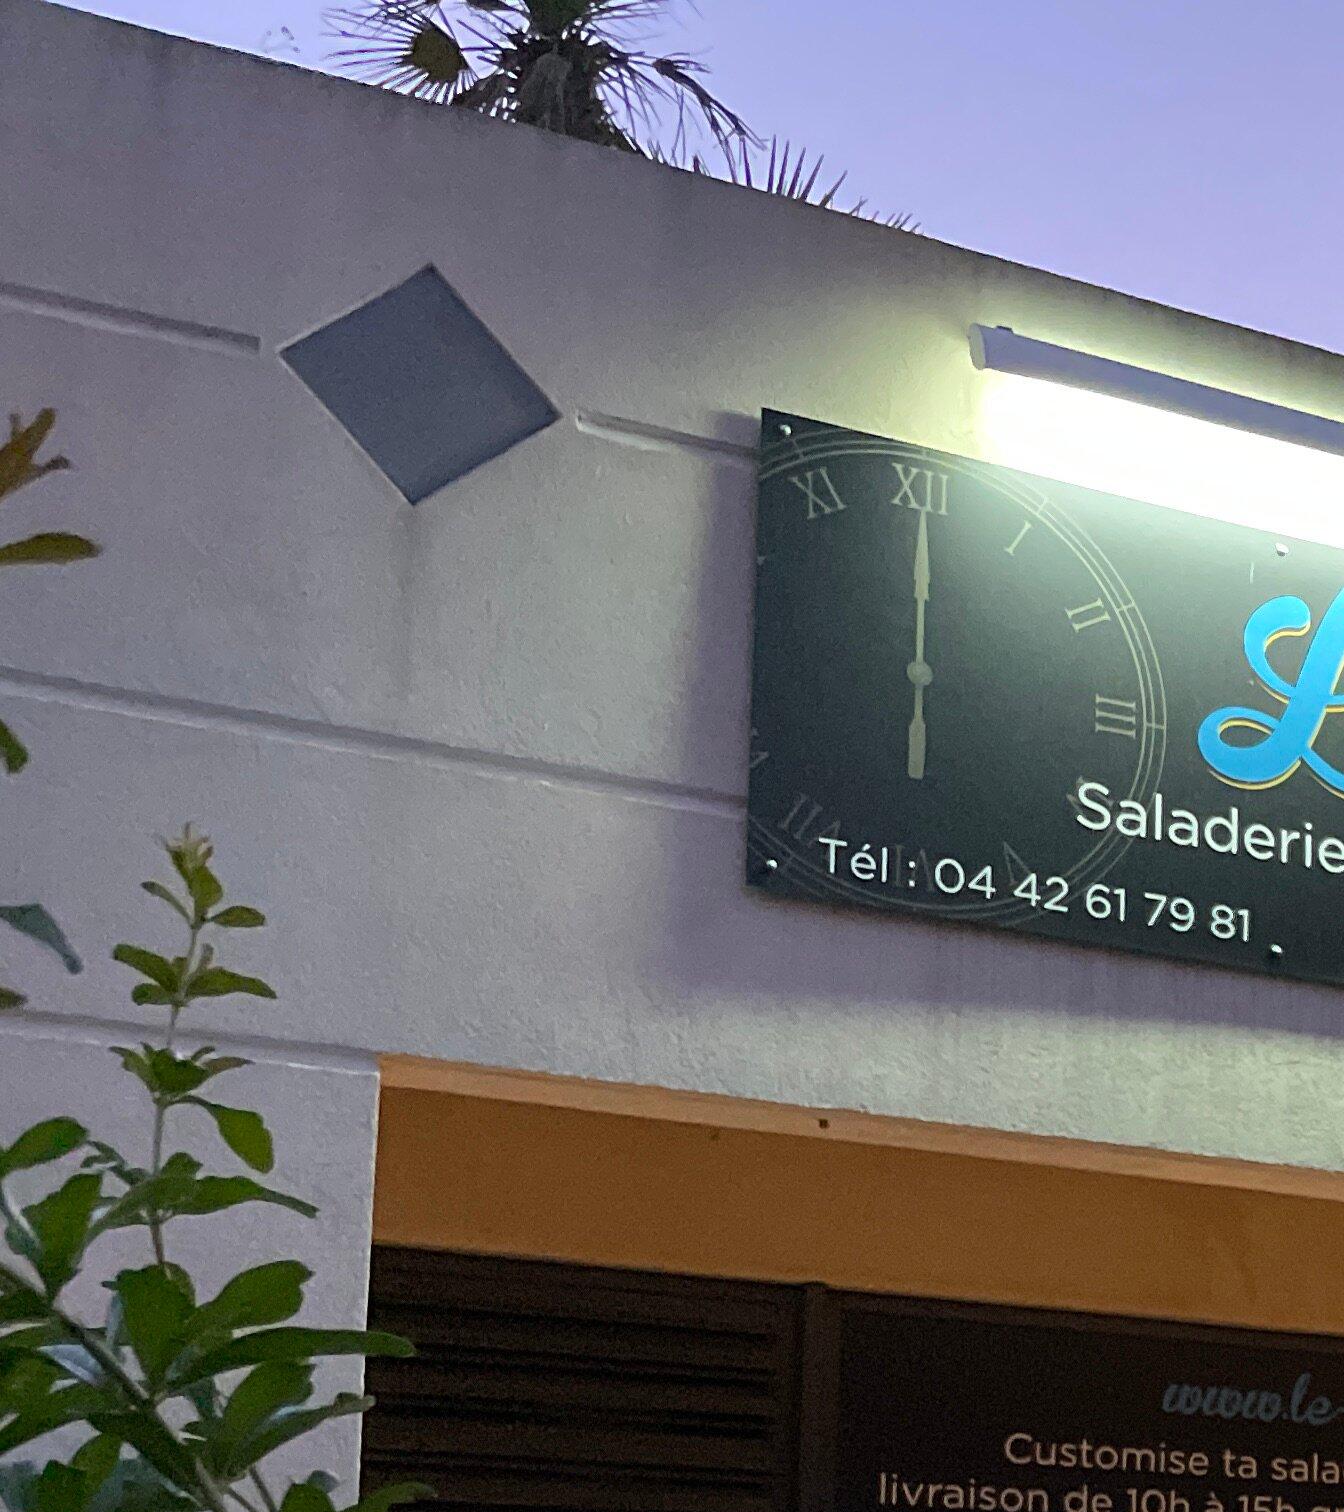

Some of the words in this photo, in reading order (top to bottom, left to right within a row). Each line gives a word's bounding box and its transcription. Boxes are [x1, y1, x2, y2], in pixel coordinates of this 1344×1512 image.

[890, 462, 949, 516] XII
[818, 836, 889, 882] Tél
[935, 858, 997, 899] 04
[1013, 873, 1070, 912] 42
[1085, 883, 1125, 922] 61
[1144, 892, 1196, 931] 79
[1211, 904, 1249, 942] 81
[1003, 1432, 1210, 1476] Customise
[1222, 1448, 1258, 1479] ta
